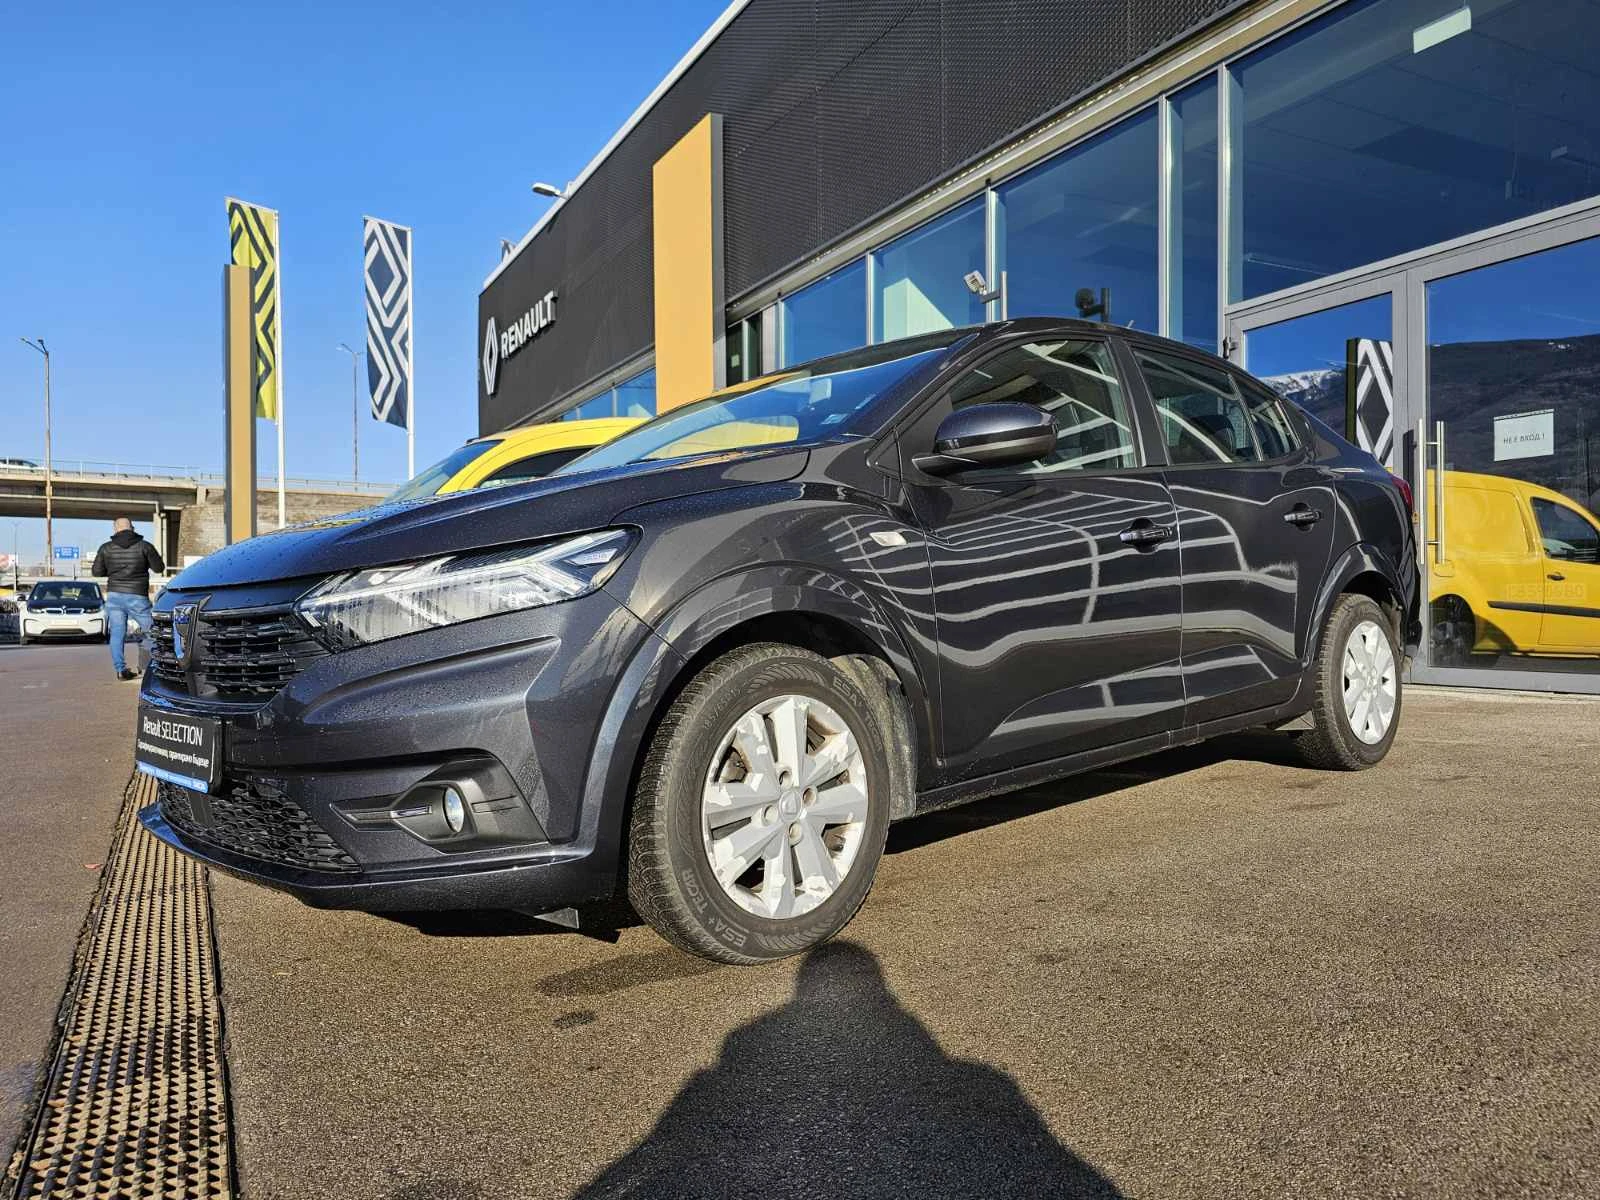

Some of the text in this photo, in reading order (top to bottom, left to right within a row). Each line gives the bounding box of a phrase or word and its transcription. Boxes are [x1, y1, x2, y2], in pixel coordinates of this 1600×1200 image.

[501, 290, 555, 359] RENAULT
[144, 716, 203, 746] Renault SELECTION
